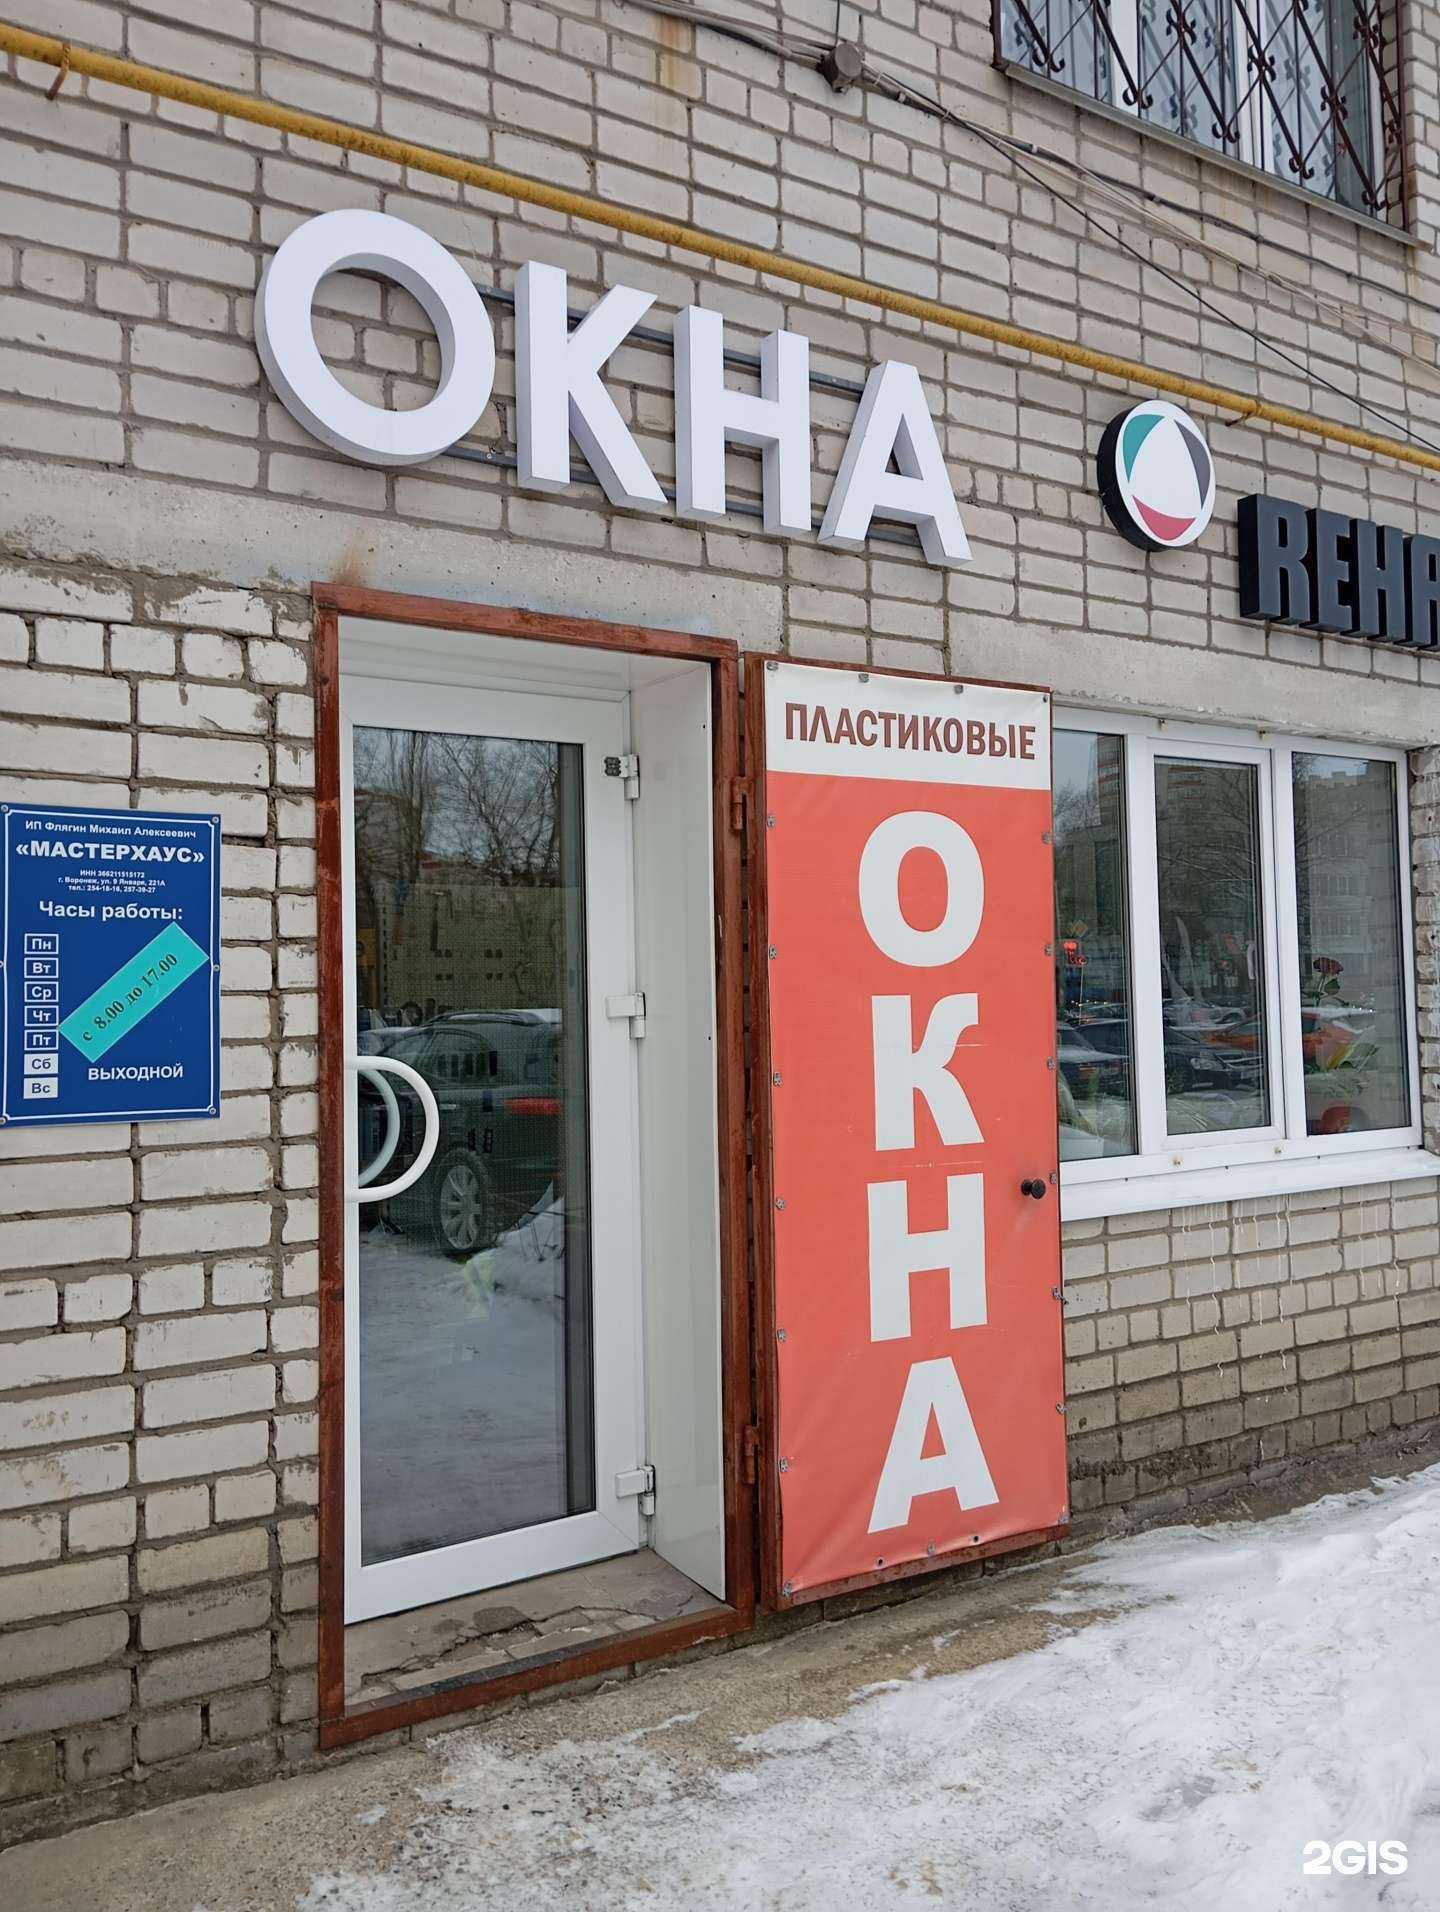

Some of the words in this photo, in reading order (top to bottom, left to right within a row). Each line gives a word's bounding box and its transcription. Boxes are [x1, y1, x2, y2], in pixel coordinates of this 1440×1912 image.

[255, 209, 974, 567] ОКНА
[785, 702, 1036, 760] ПЛАСТИКОВЫЕ
[25, 820, 42, 830] ИП
[44, 822, 87, 833] Флягин
[89, 824, 131, 835] Михаил
[134, 827, 197, 839] Алексеевич
[15, 840, 205, 863] «МАСТЕРХАУС»
[80, 869, 96, 877] ИНН
[39, 900, 96, 918] Часы
[102, 902, 183, 922] работы:
[31, 938, 52, 950] Пн
[32, 962, 52, 974] Вт
[126, 986, 143, 1007] до
[141, 953, 178, 988] 17.00
[31, 986, 52, 1001] Ср
[32, 1010, 52, 1022] Чт
[32, 1034, 52, 1046] Пт
[31, 1058, 52, 1070] Сб
[87, 1062, 184, 1082] ВЫХОДНОЙ
[31, 1082, 51, 1094] Вс
[858, 811, 999, 1533] ОКНА
